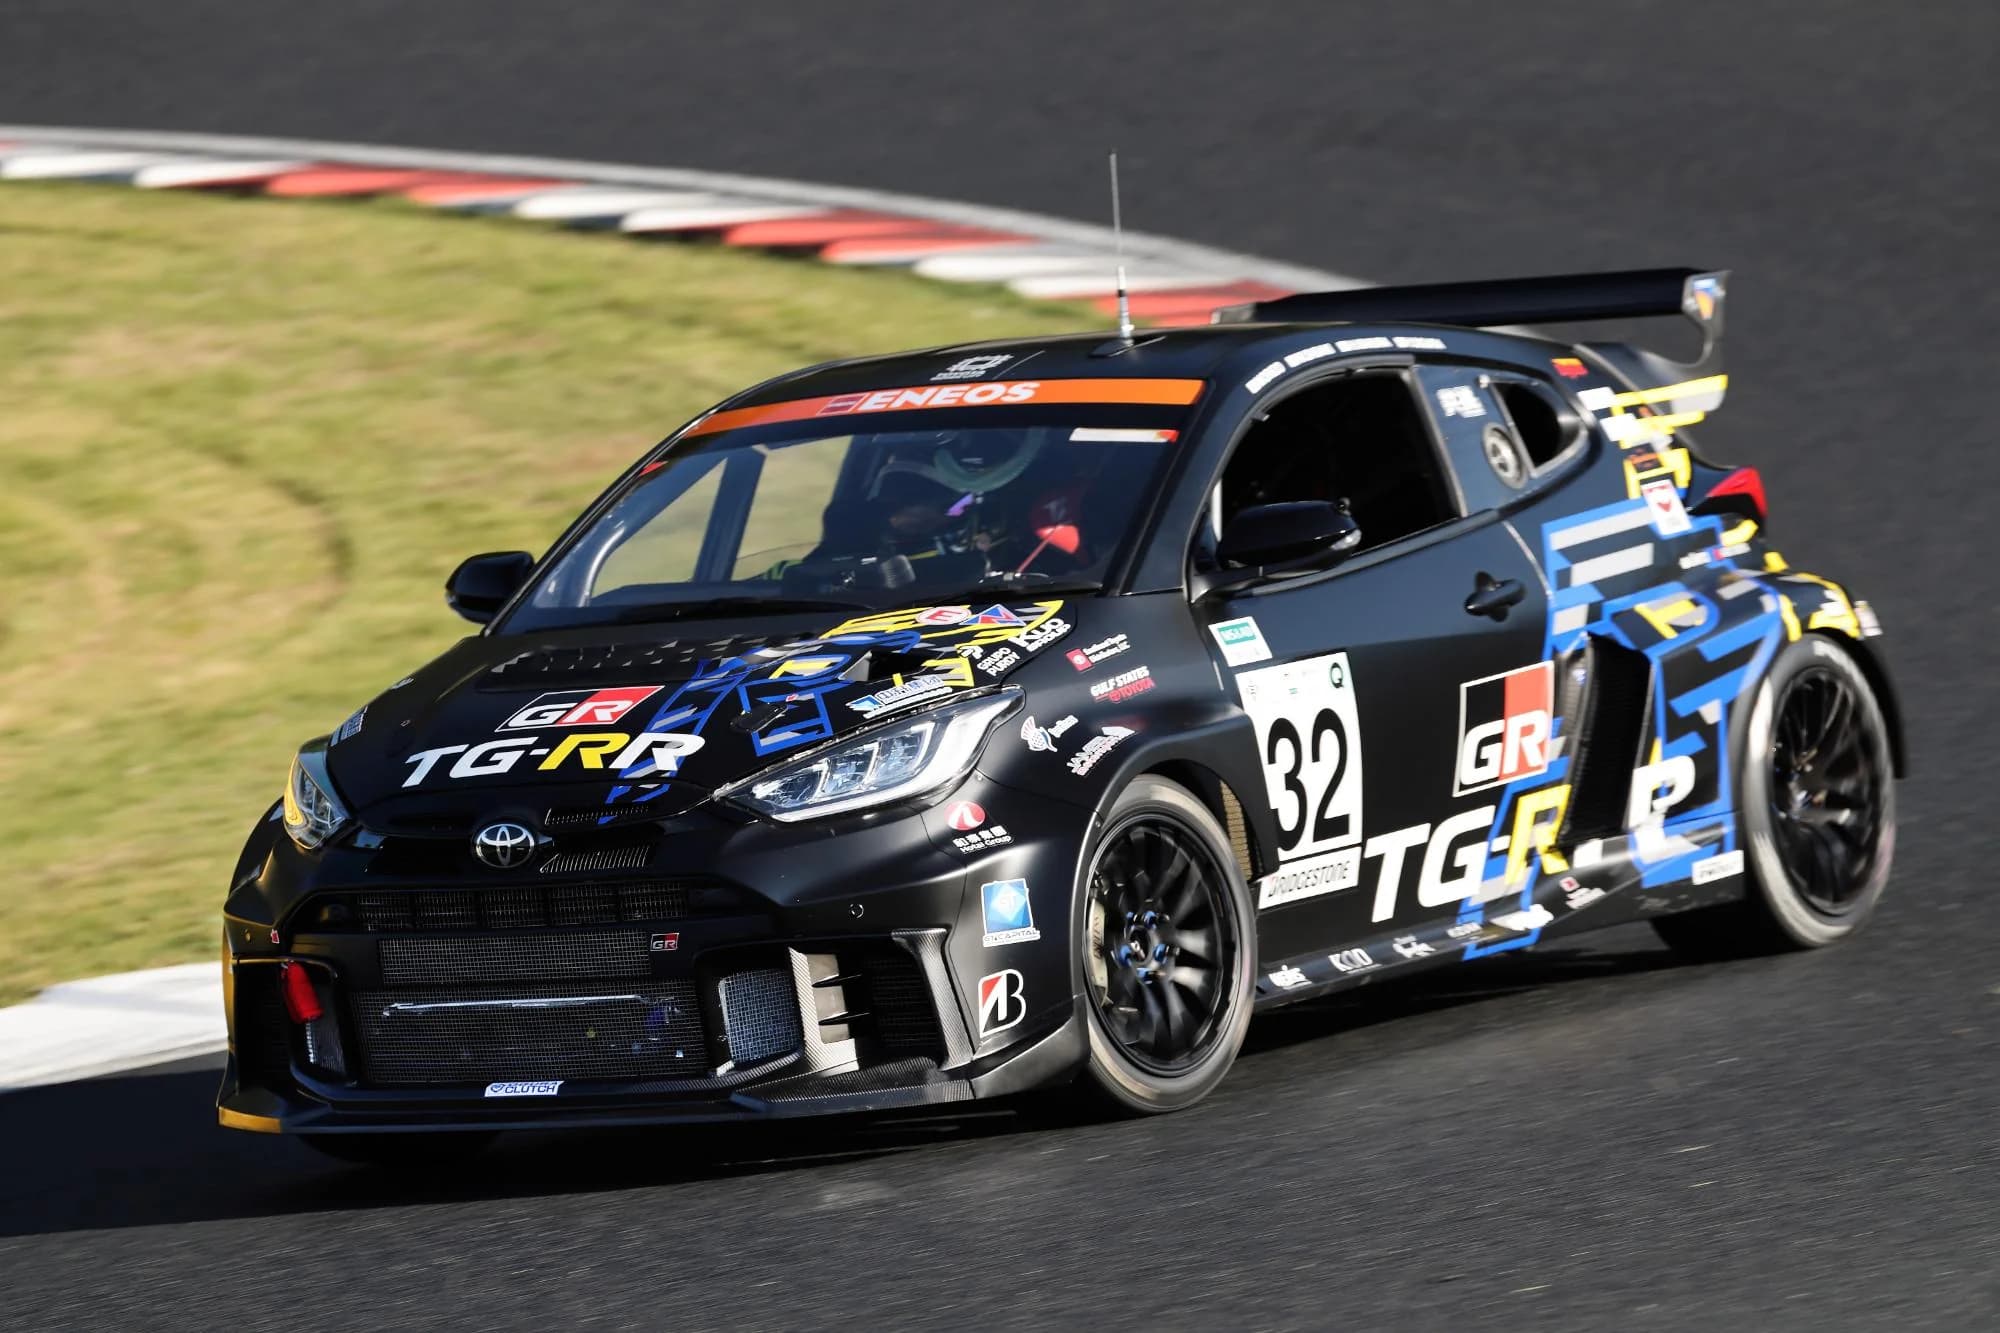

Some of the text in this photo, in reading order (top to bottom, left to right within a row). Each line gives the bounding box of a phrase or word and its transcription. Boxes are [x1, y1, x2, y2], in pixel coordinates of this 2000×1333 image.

[857, 382, 1041, 411] ENEOS
[1008, 618, 1065, 647] KUO
[977, 647, 1011, 670] GRUPO
[986, 651, 1020, 676] PURDY
[1090, 665, 1149, 697] GULF STATES
[507, 700, 635, 728] GR
[402, 732, 706, 788] TG-RR
[1460, 710, 1549, 786] GR
[1267, 708, 1350, 852] 32
[652, 940, 676, 949] GR
[504, 1085, 555, 1094] CLUTCH
